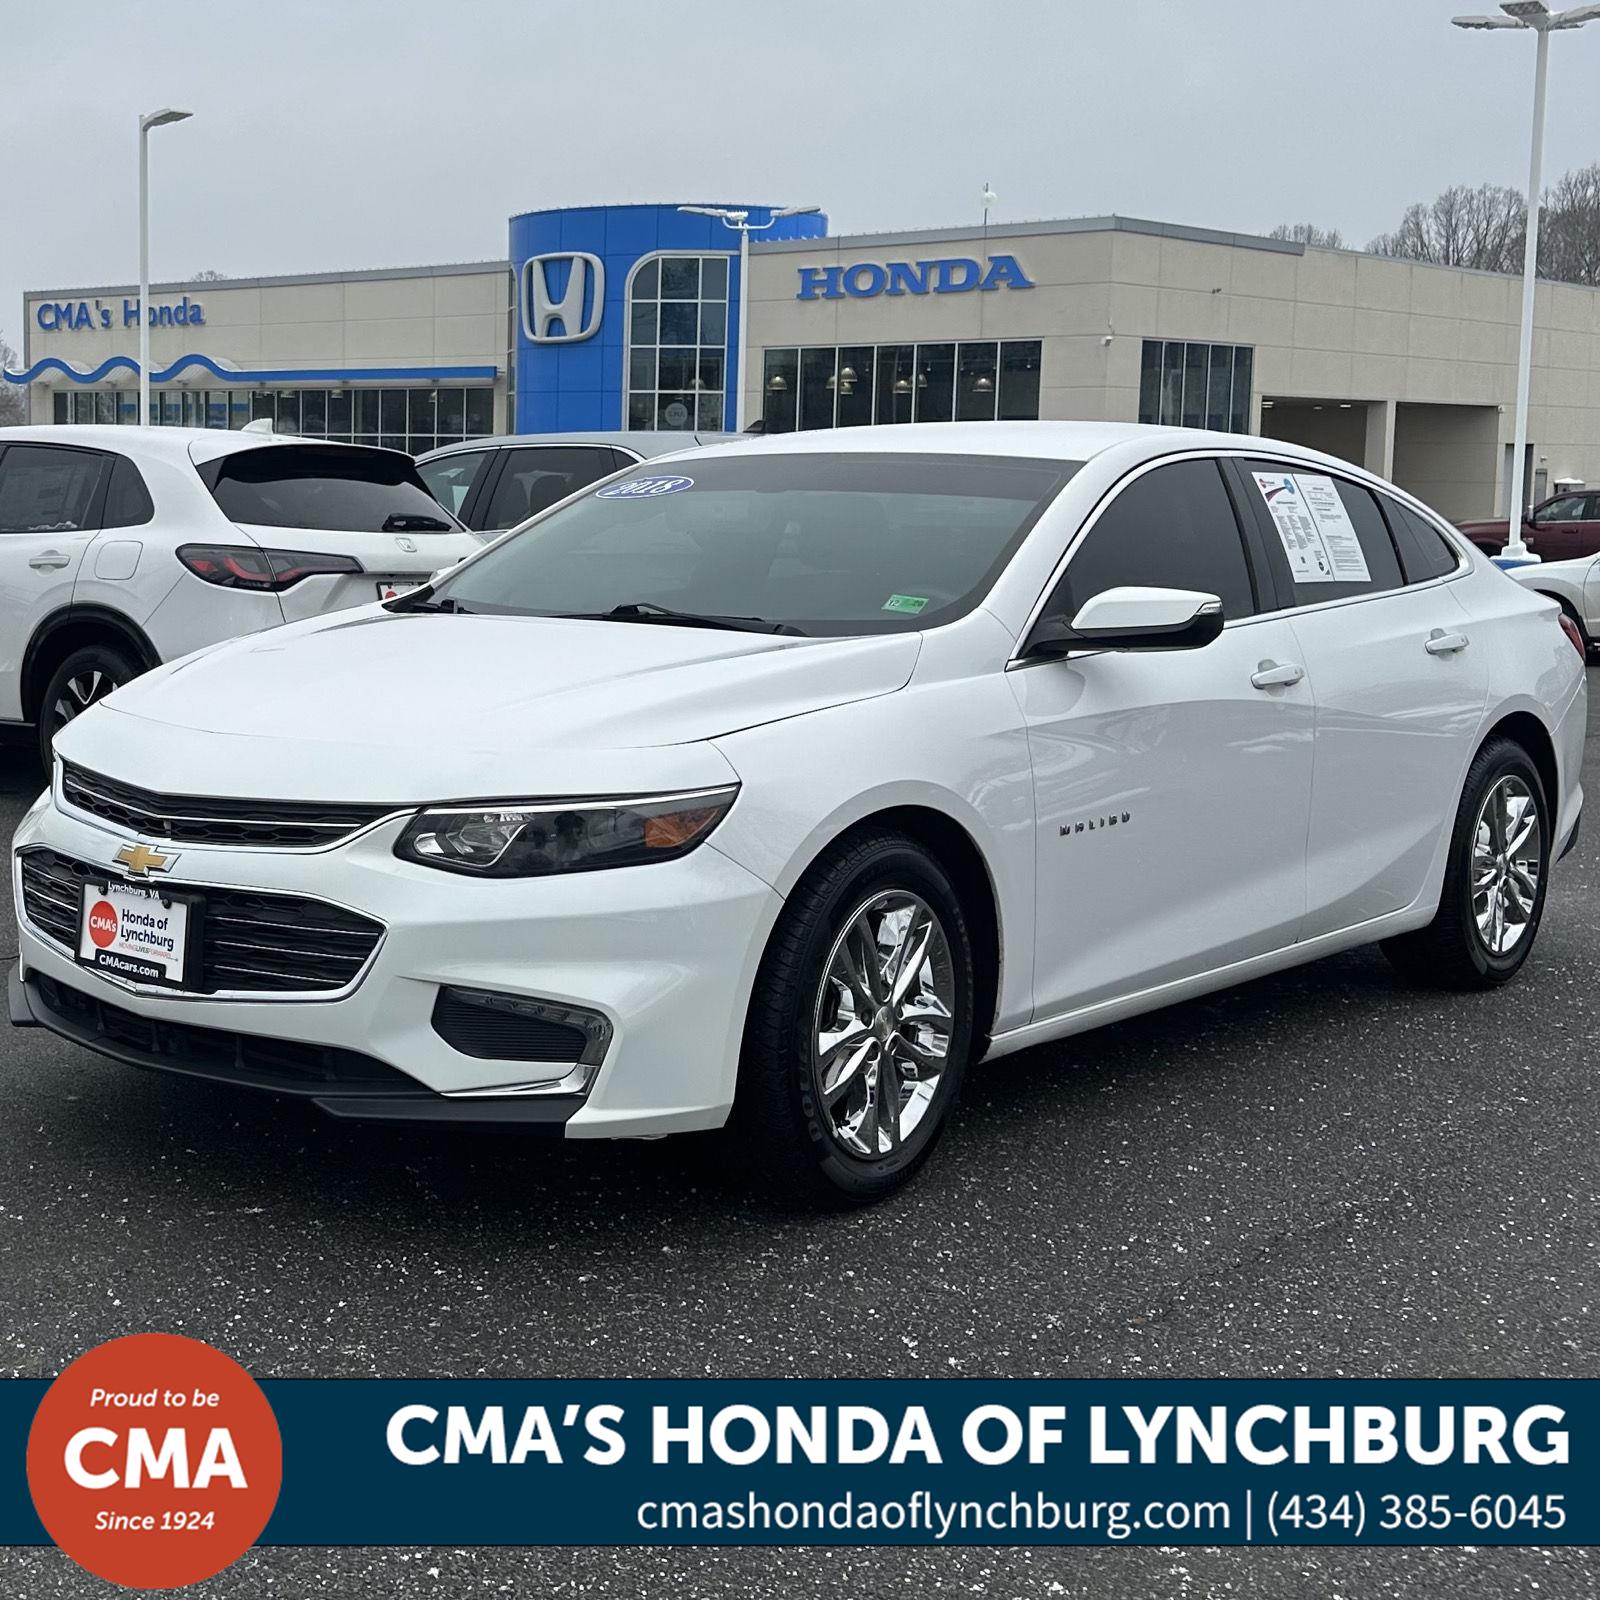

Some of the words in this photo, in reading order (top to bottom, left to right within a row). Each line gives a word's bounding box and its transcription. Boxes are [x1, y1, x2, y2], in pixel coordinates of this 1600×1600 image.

[797, 255, 1036, 300] HONDA
[37, 300, 113, 331] CMA's
[123, 296, 205, 328] Honda
[1059, 811, 1131, 837] MALIBU
[149, 889, 160, 899] VA
[90, 915, 117, 933] CMA's
[121, 908, 155, 929] Honda
[156, 917, 169, 931] of
[120, 924, 175, 952] Lynchburg
[99, 953, 160, 979] CMAcars.com
